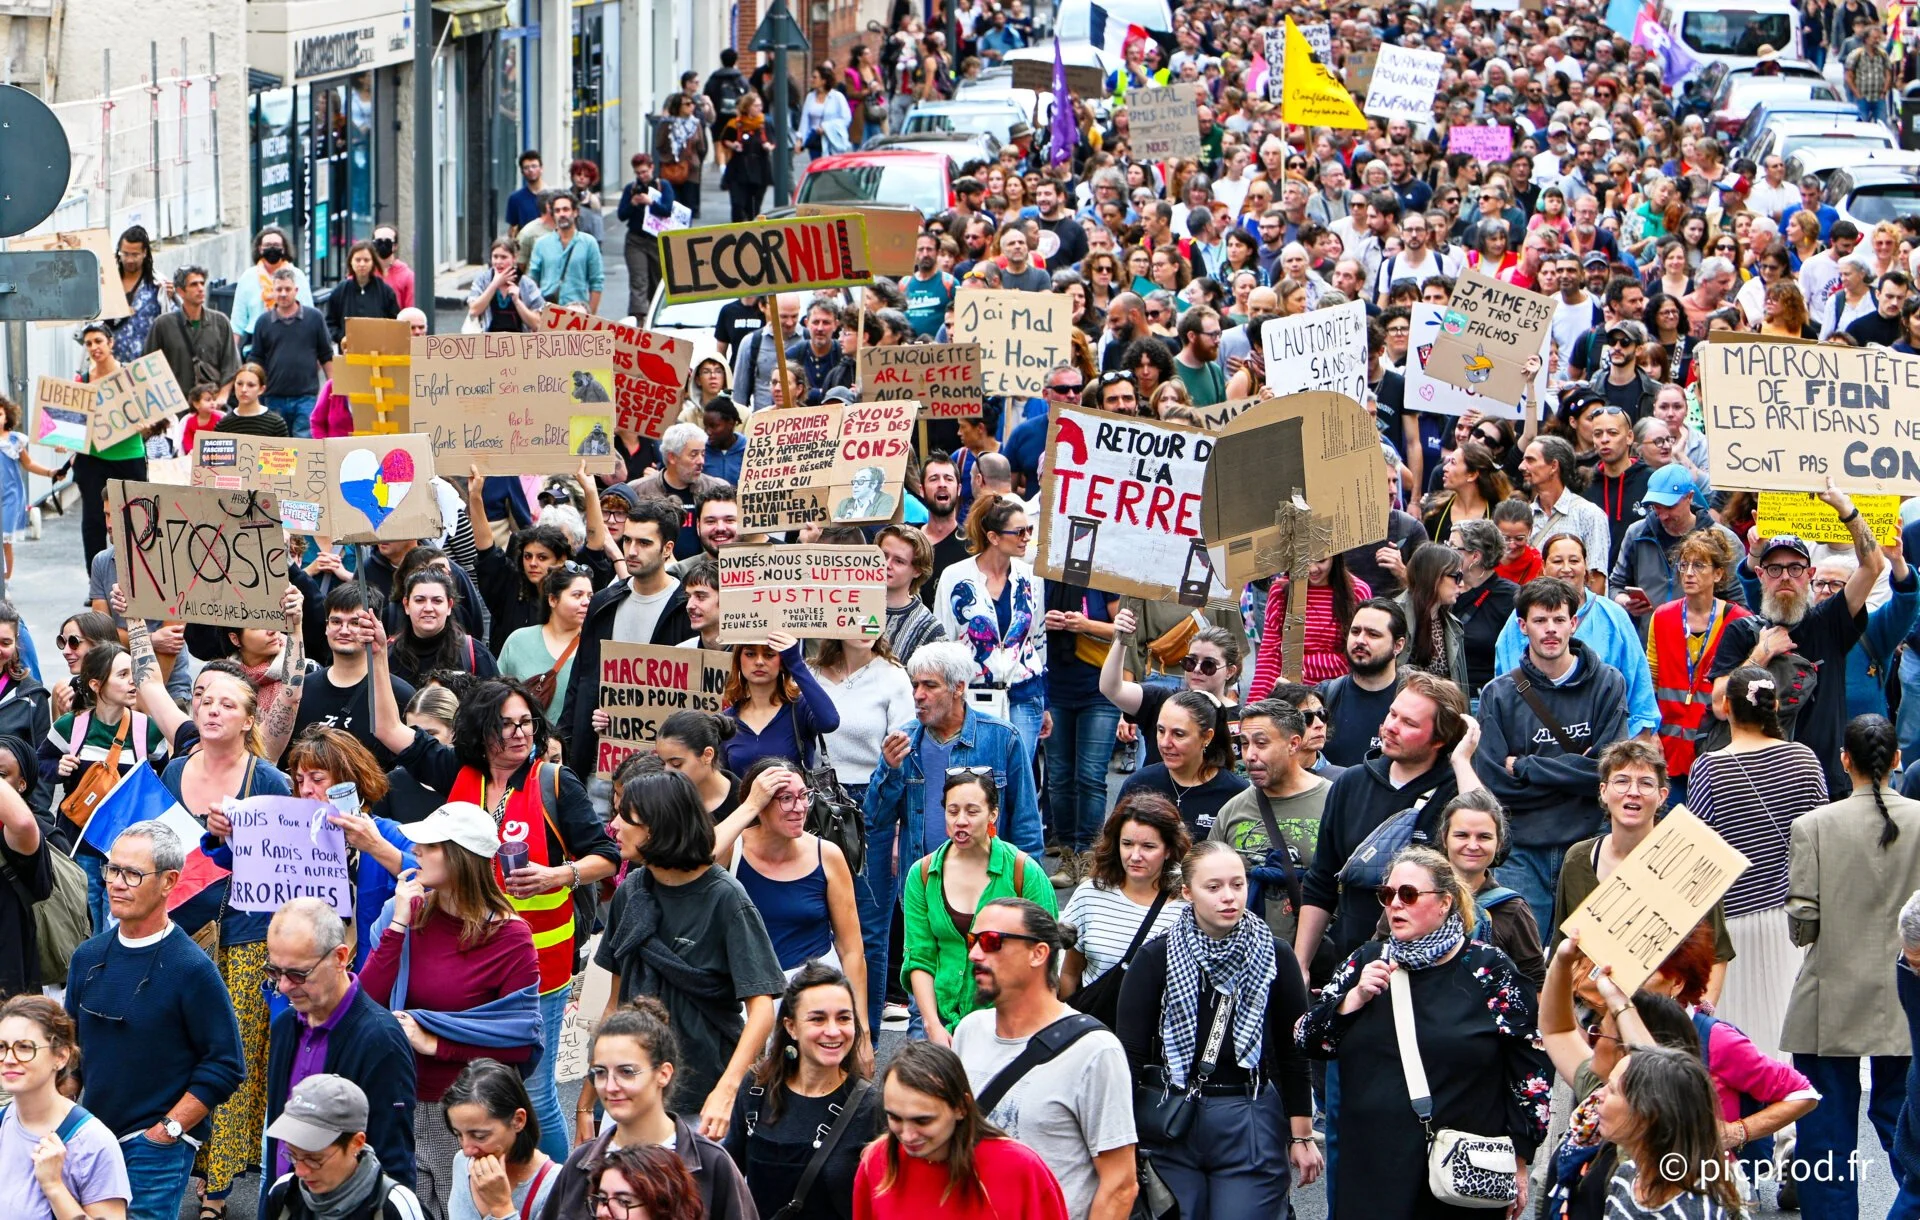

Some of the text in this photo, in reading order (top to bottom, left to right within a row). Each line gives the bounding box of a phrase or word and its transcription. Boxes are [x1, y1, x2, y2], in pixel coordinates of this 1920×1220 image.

[1127, 88, 1182, 108] TOTAL
[662, 219, 871, 294] LECORNUL
[961, 297, 1002, 332] J'ai
[1011, 308, 1053, 333] Mal
[1451, 295, 1538, 332] TRO TRO LES
[1526, 300, 1551, 321] PAS
[1467, 320, 1520, 345] FACHOS
[427, 335, 476, 360] POV
[485, 335, 516, 359] LA
[1311, 352, 1346, 379] SANS
[1723, 344, 1920, 389] MACRON TÊTE
[414, 373, 454, 406] Enfant
[929, 383, 981, 403] PROMO
[1758, 379, 1796, 406] DE
[931, 401, 980, 416] PROMO
[1714, 405, 1756, 430] LES
[754, 413, 830, 437] SUPPRIMER
[843, 418, 880, 436] ÊTES
[749, 429, 828, 449] LES EXAMENS
[778, 440, 818, 456] APPREND
[1096, 422, 1185, 464] RETOUR
[777, 454, 793, 464] UNE
[797, 449, 824, 462] SORTE
[1799, 454, 1829, 475] PAS
[745, 464, 797, 480] RACISME
[1136, 459, 1172, 486] LA
[755, 478, 785, 491] CEUX
[790, 475, 812, 487] QUI
[742, 494, 820, 514] TRAVAILLER À
[743, 489, 794, 505] PEUVENT
[1053, 468, 1202, 538] TERRE
[743, 512, 779, 528] PLEIN
[1815, 523, 1831, 531] LES
[752, 588, 861, 603] JUSTICE
[200, 602, 223, 617] COPS
[224, 605, 241, 621] ARE
[725, 611, 760, 621] POUR LA
[783, 606, 825, 616] POUR LES
[790, 613, 824, 622] PEUPLES
[838, 606, 862, 614] POUR
[721, 618, 769, 630] JEUNESSE
[837, 615, 878, 627] GAZA
[603, 657, 689, 690] MACRON
[600, 685, 720, 712] PREND POUR DES
[279, 814, 300, 828] POUR
[235, 845, 252, 857] UN
[312, 847, 342, 865] POUR
[1639, 827, 1695, 881] ALLO
[274, 864, 348, 880] LES AUTRES
[1586, 876, 1680, 970] ICI LA TERRE
